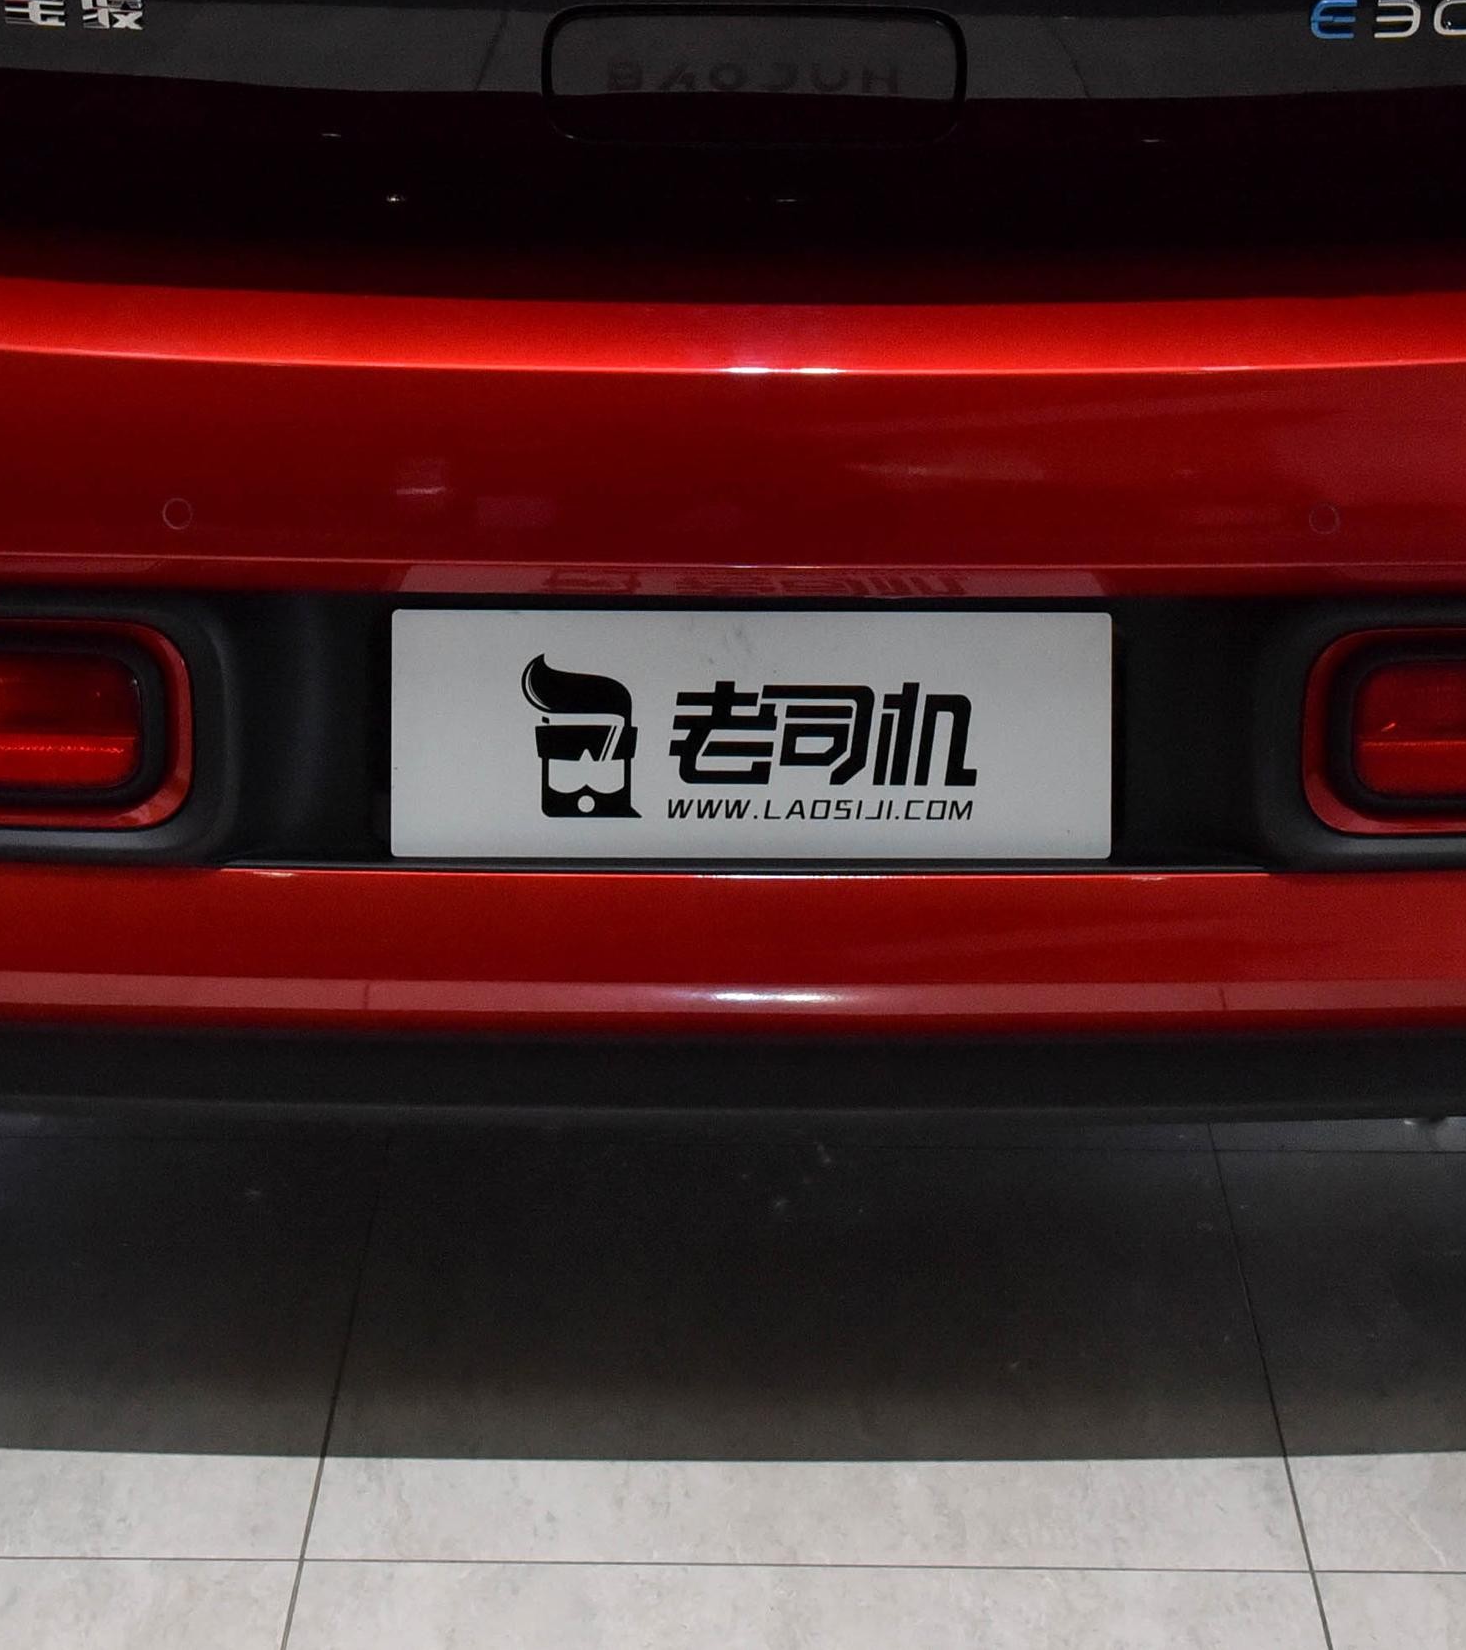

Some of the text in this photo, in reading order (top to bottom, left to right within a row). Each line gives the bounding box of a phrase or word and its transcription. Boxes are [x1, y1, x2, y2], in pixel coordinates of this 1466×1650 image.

[605, 58, 901, 94] BAOJUN
[668, 681, 978, 787] 老司机
[666, 798, 975, 822] WWW.LAOSIJI.COM
